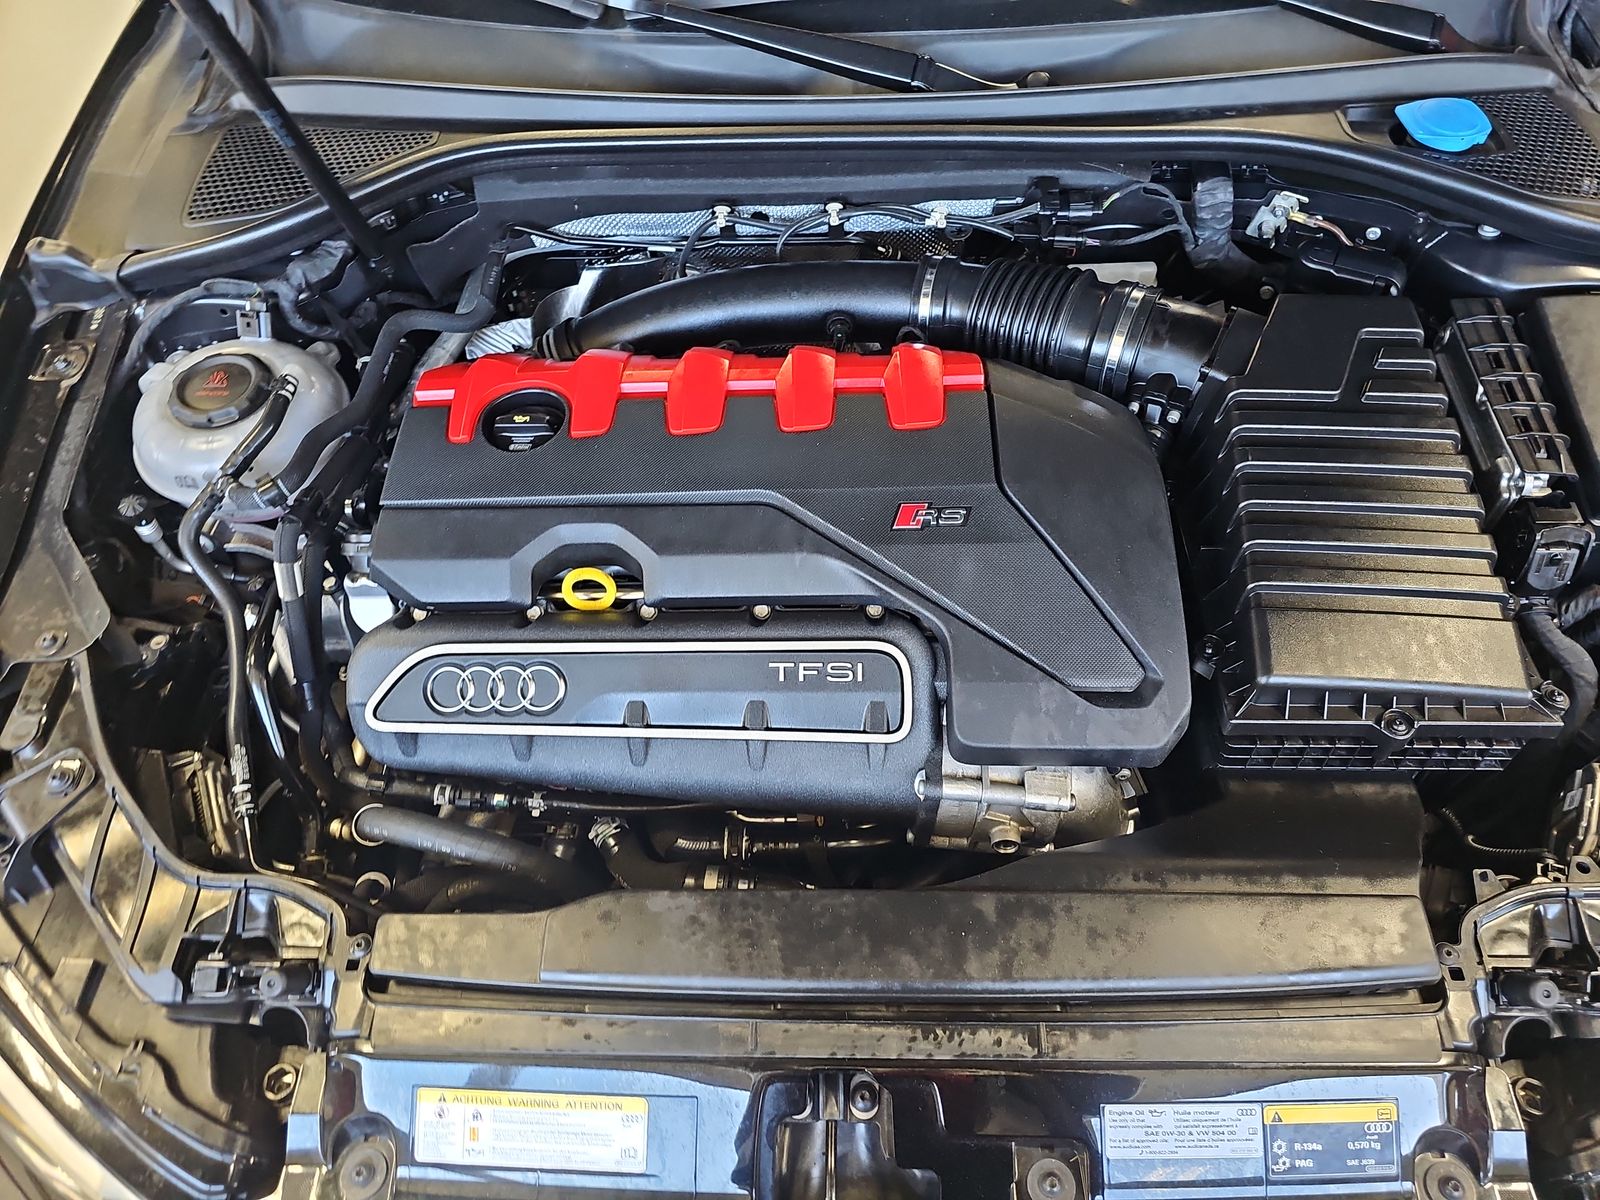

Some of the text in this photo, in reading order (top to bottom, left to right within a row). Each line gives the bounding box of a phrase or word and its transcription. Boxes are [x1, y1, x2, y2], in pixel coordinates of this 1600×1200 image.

[768, 662, 863, 682] TFSI
[453, 1095, 623, 1111] ACHTUNG WARNING ATTENTION
[1108, 1109, 1133, 1117] Engine
[1294, 1141, 1381, 1150] R-134a 0,570 kg
[1295, 1159, 1313, 1167] PAG
